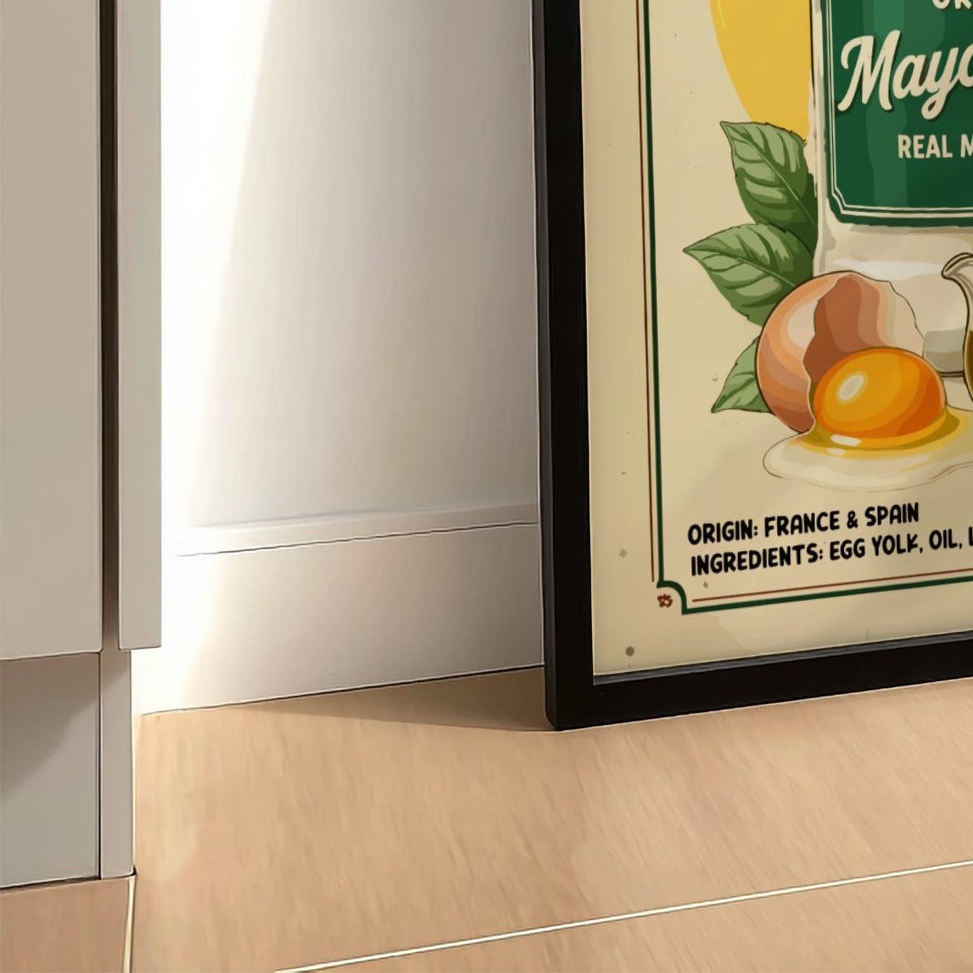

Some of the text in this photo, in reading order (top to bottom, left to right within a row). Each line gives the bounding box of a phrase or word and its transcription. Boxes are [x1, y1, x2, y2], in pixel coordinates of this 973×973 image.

[897, 134, 953, 159] REAL
[687, 502, 919, 545] ORIGIN: FRANCE & SPAIN
[691, 542, 823, 576] INGREDIENTS:
[829, 538, 866, 561] EGG
[871, 533, 923, 556] YOLK,
[928, 528, 963, 550] OIL,
